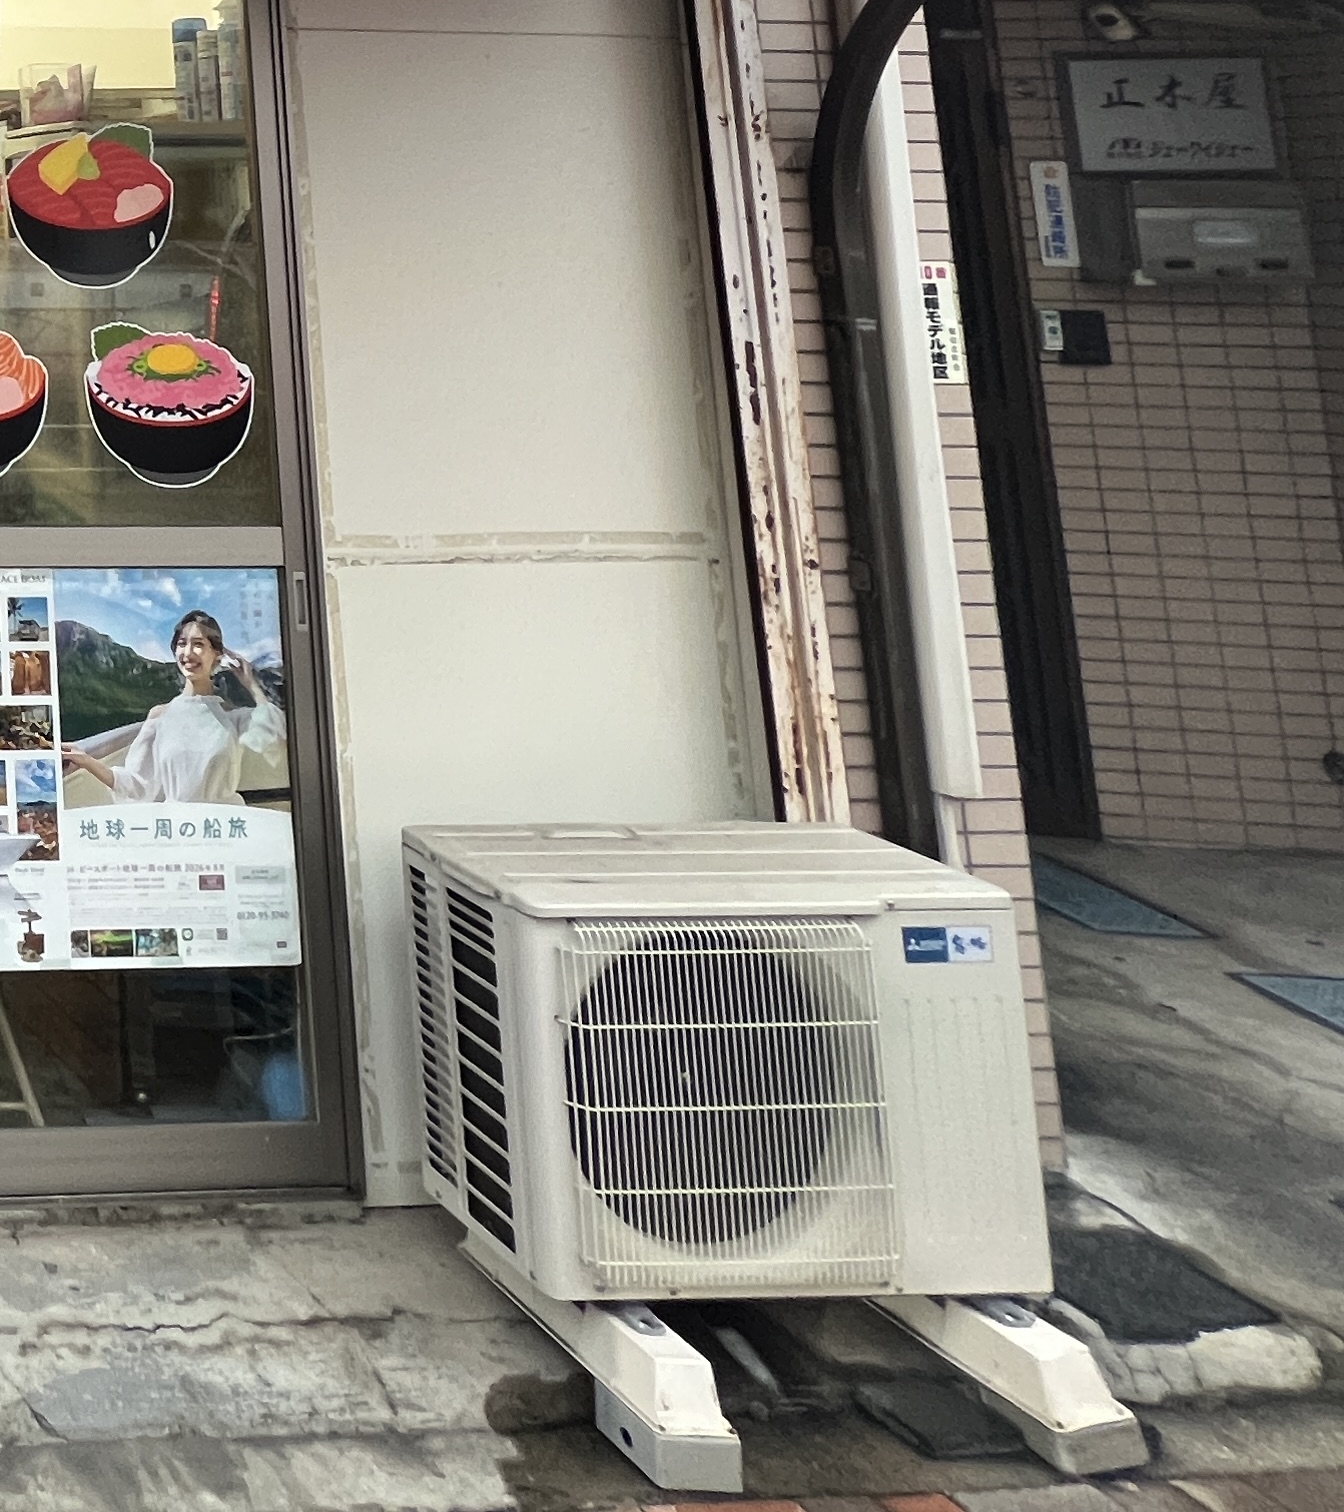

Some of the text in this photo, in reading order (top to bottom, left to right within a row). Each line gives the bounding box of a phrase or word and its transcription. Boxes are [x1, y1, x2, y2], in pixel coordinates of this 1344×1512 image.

[79, 816, 248, 840] 地球一周の船旅
